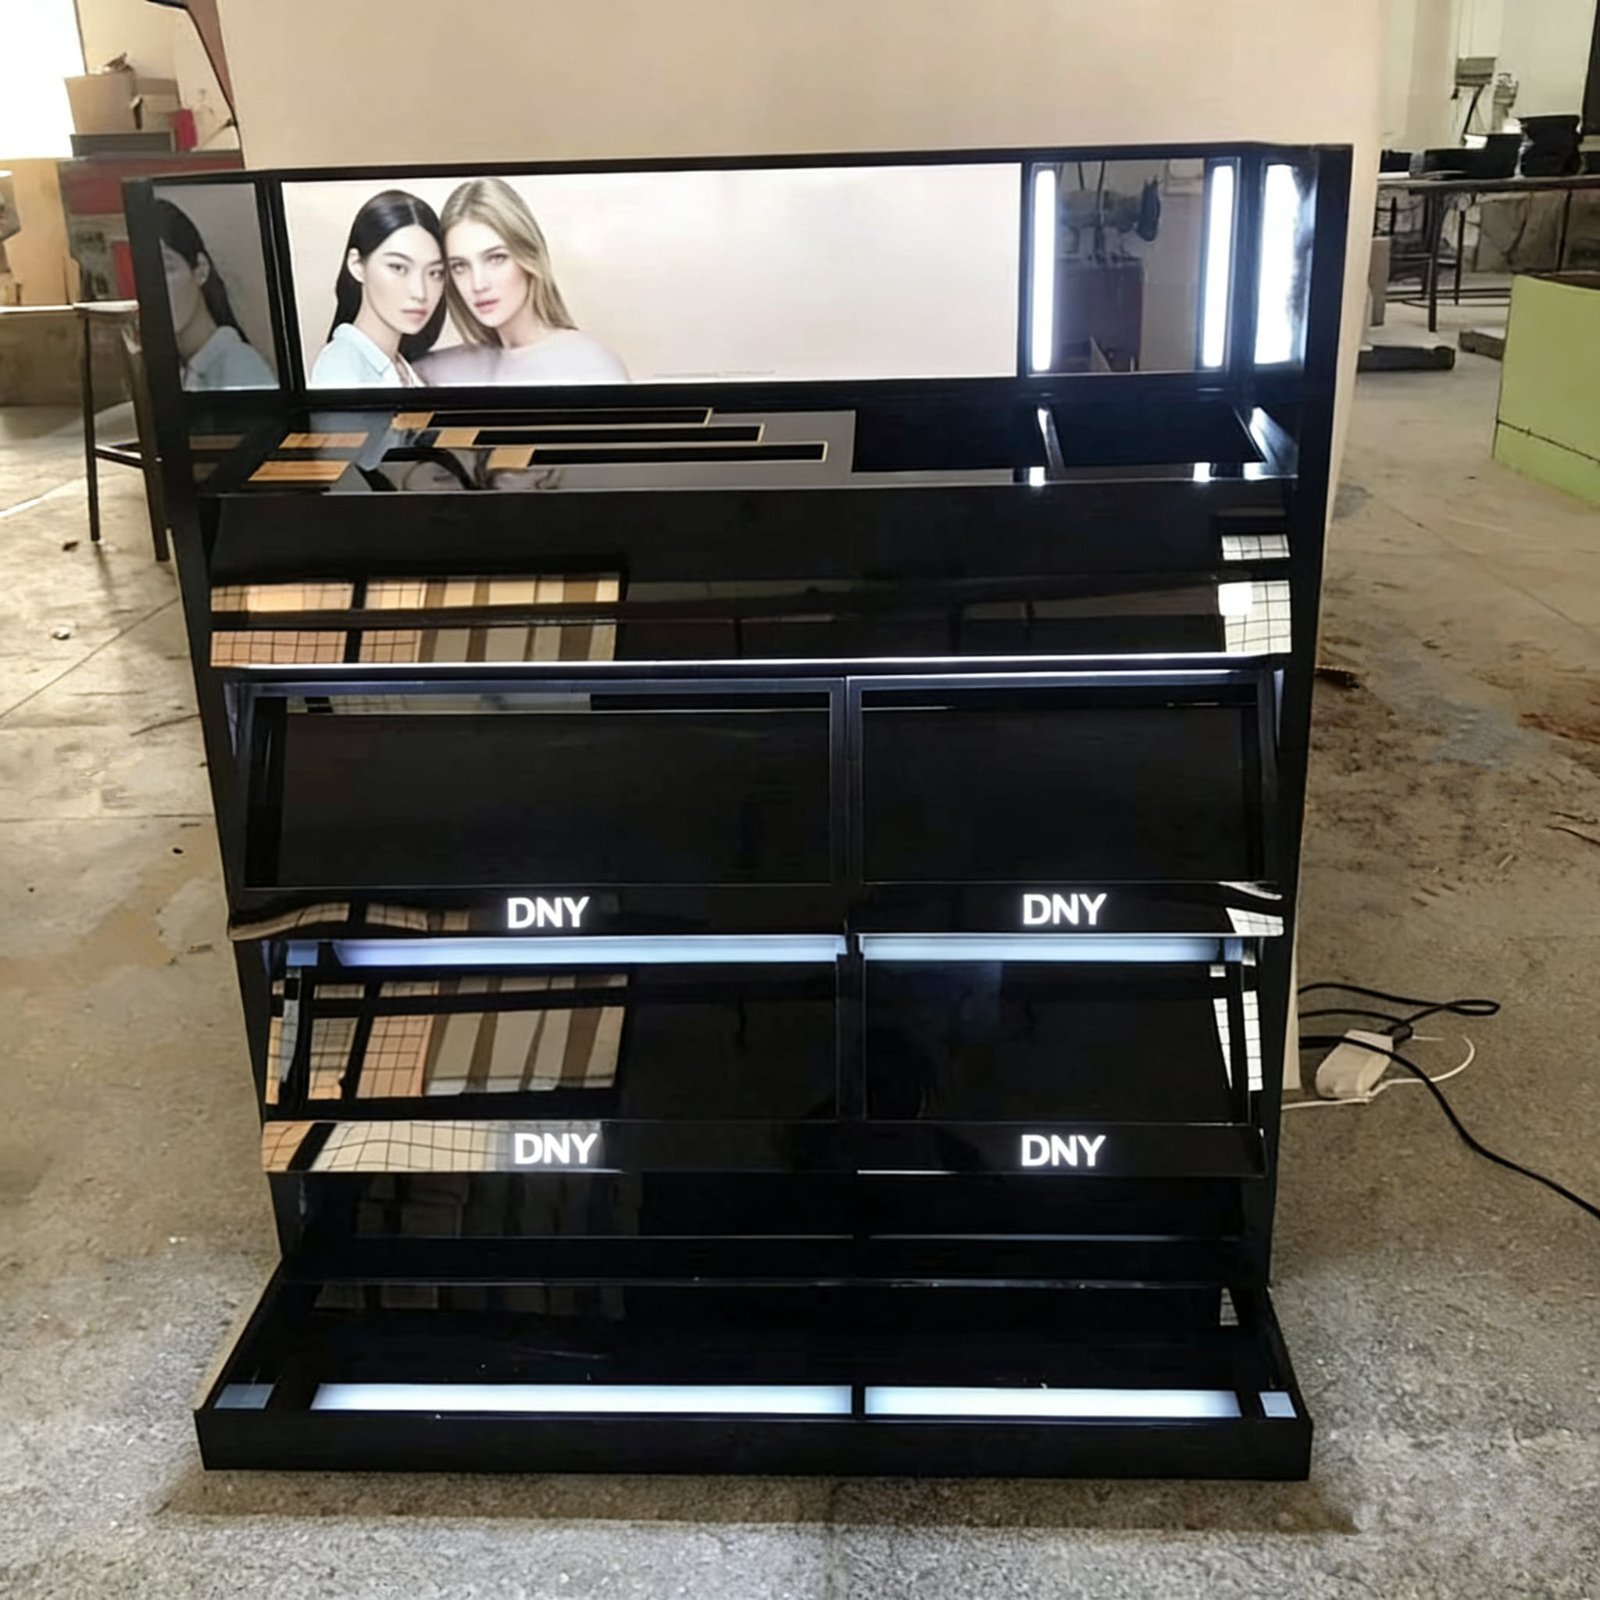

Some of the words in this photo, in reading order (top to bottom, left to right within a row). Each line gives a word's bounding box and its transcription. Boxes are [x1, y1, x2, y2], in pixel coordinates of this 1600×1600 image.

[507, 896, 590, 929] DNY
[1022, 893, 1107, 926] DNY
[513, 1132, 598, 1165] DNY
[1021, 1134, 1106, 1167] DNY
